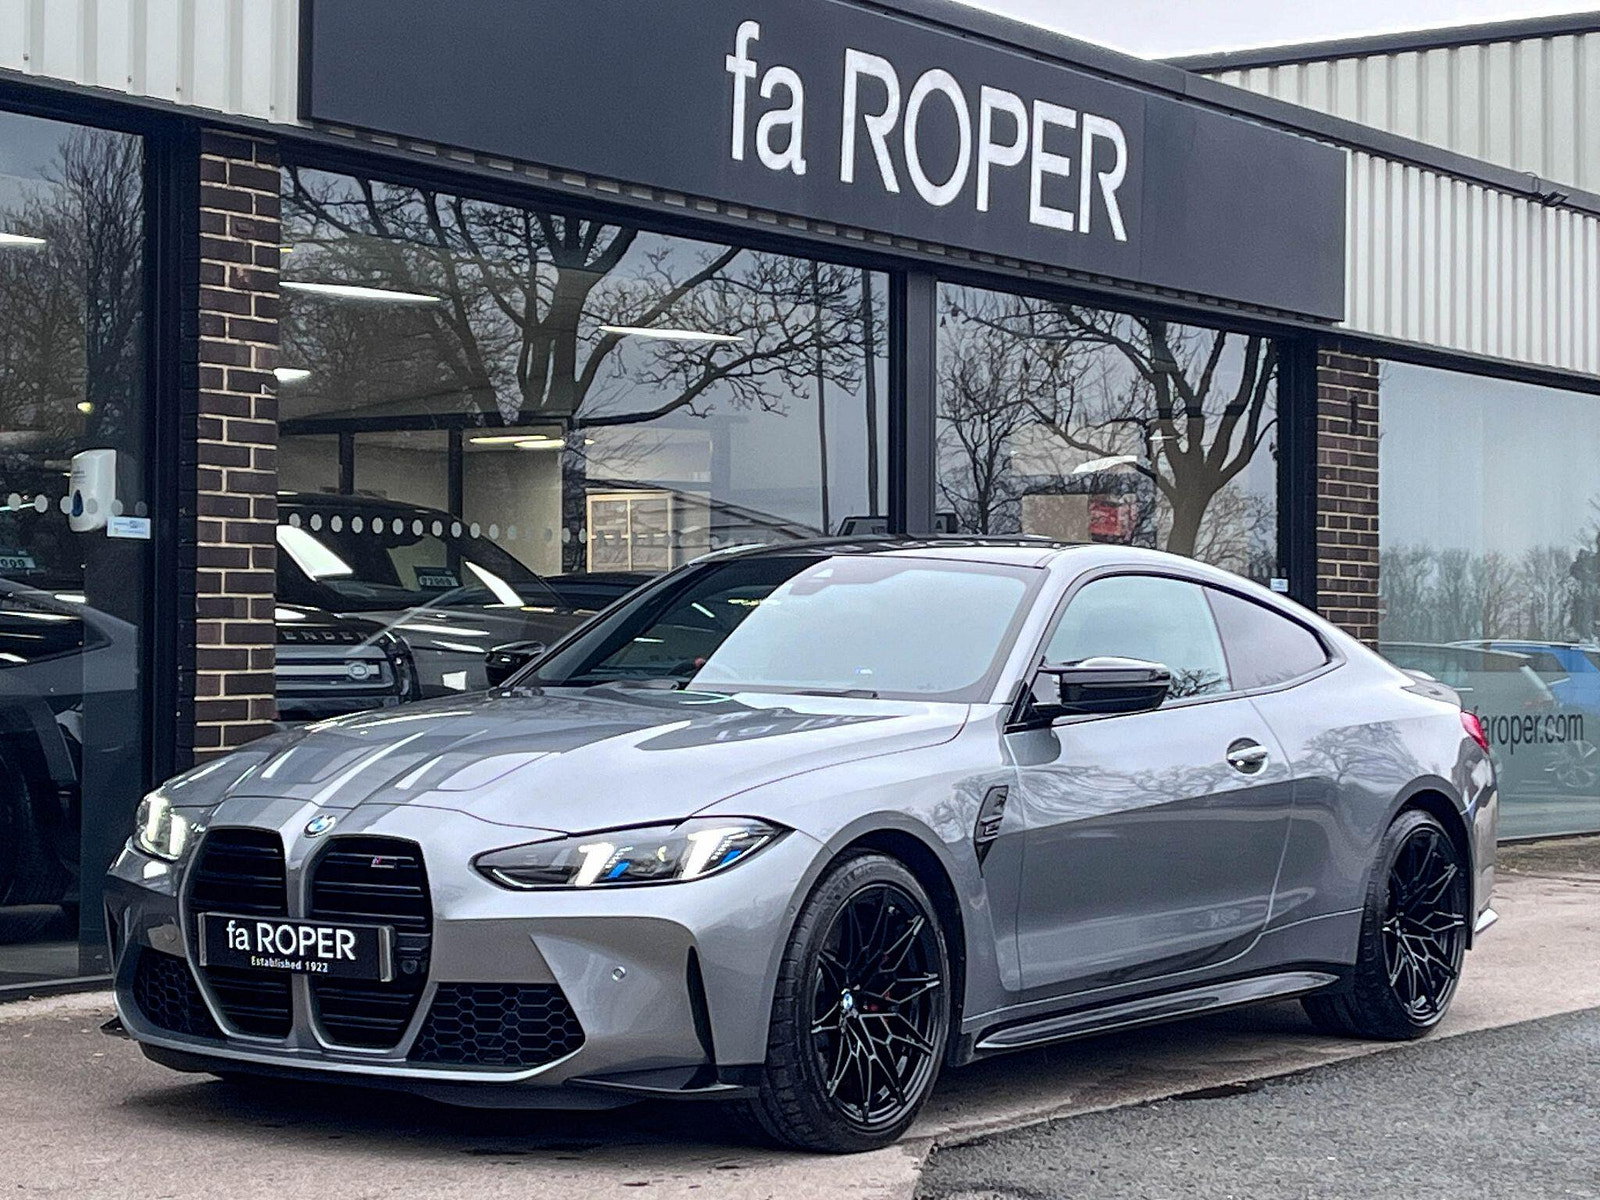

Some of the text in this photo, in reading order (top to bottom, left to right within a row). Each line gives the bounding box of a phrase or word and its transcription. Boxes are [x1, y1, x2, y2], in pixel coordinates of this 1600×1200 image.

[725, 20, 1128, 242] fa ROPER
[1474, 705, 1584, 755] aroper.com
[226, 920, 356, 960] fa ROPER
[251, 956, 328, 973] Established 1922
